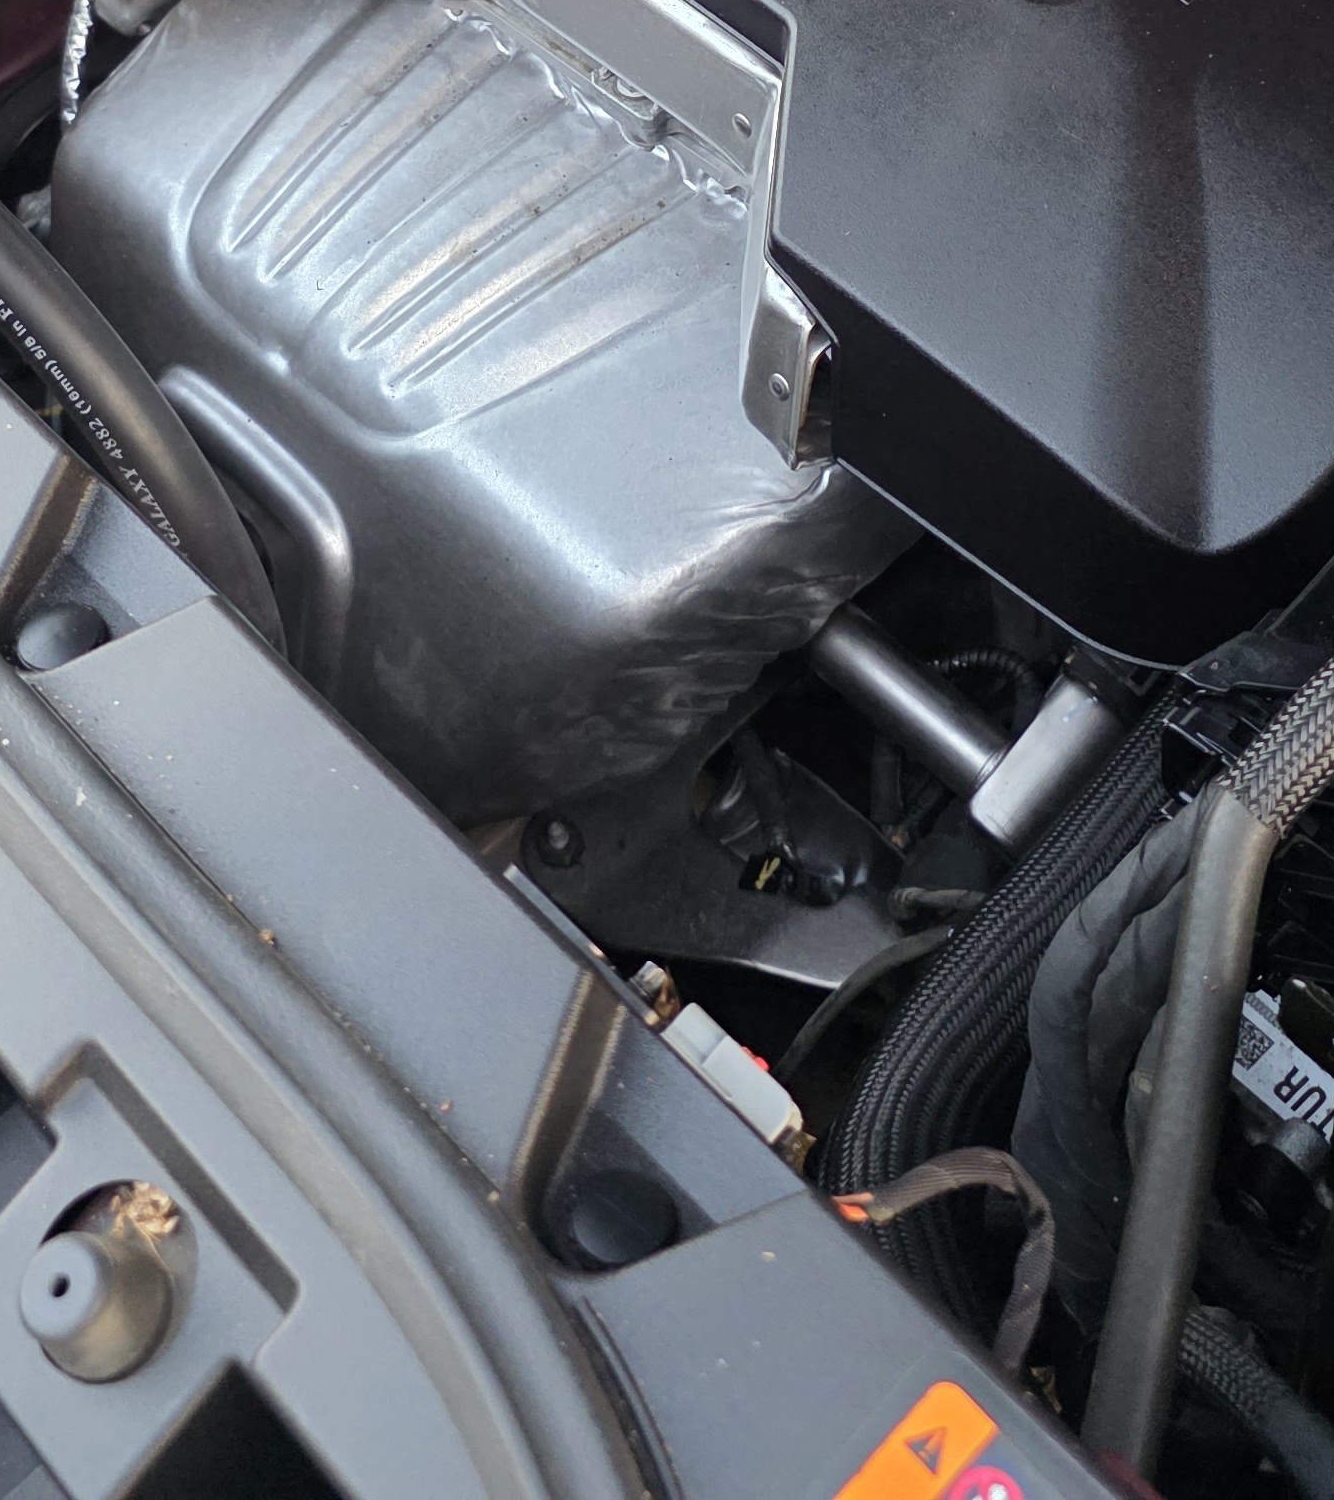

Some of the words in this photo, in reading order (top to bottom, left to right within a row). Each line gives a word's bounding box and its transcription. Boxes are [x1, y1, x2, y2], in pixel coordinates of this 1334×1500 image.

[22, 333, 48, 361] 5/8
[42, 356, 94, 417] (16mm)
[85, 413, 126, 464] 4882
[116, 458, 185, 549] GALAXY
